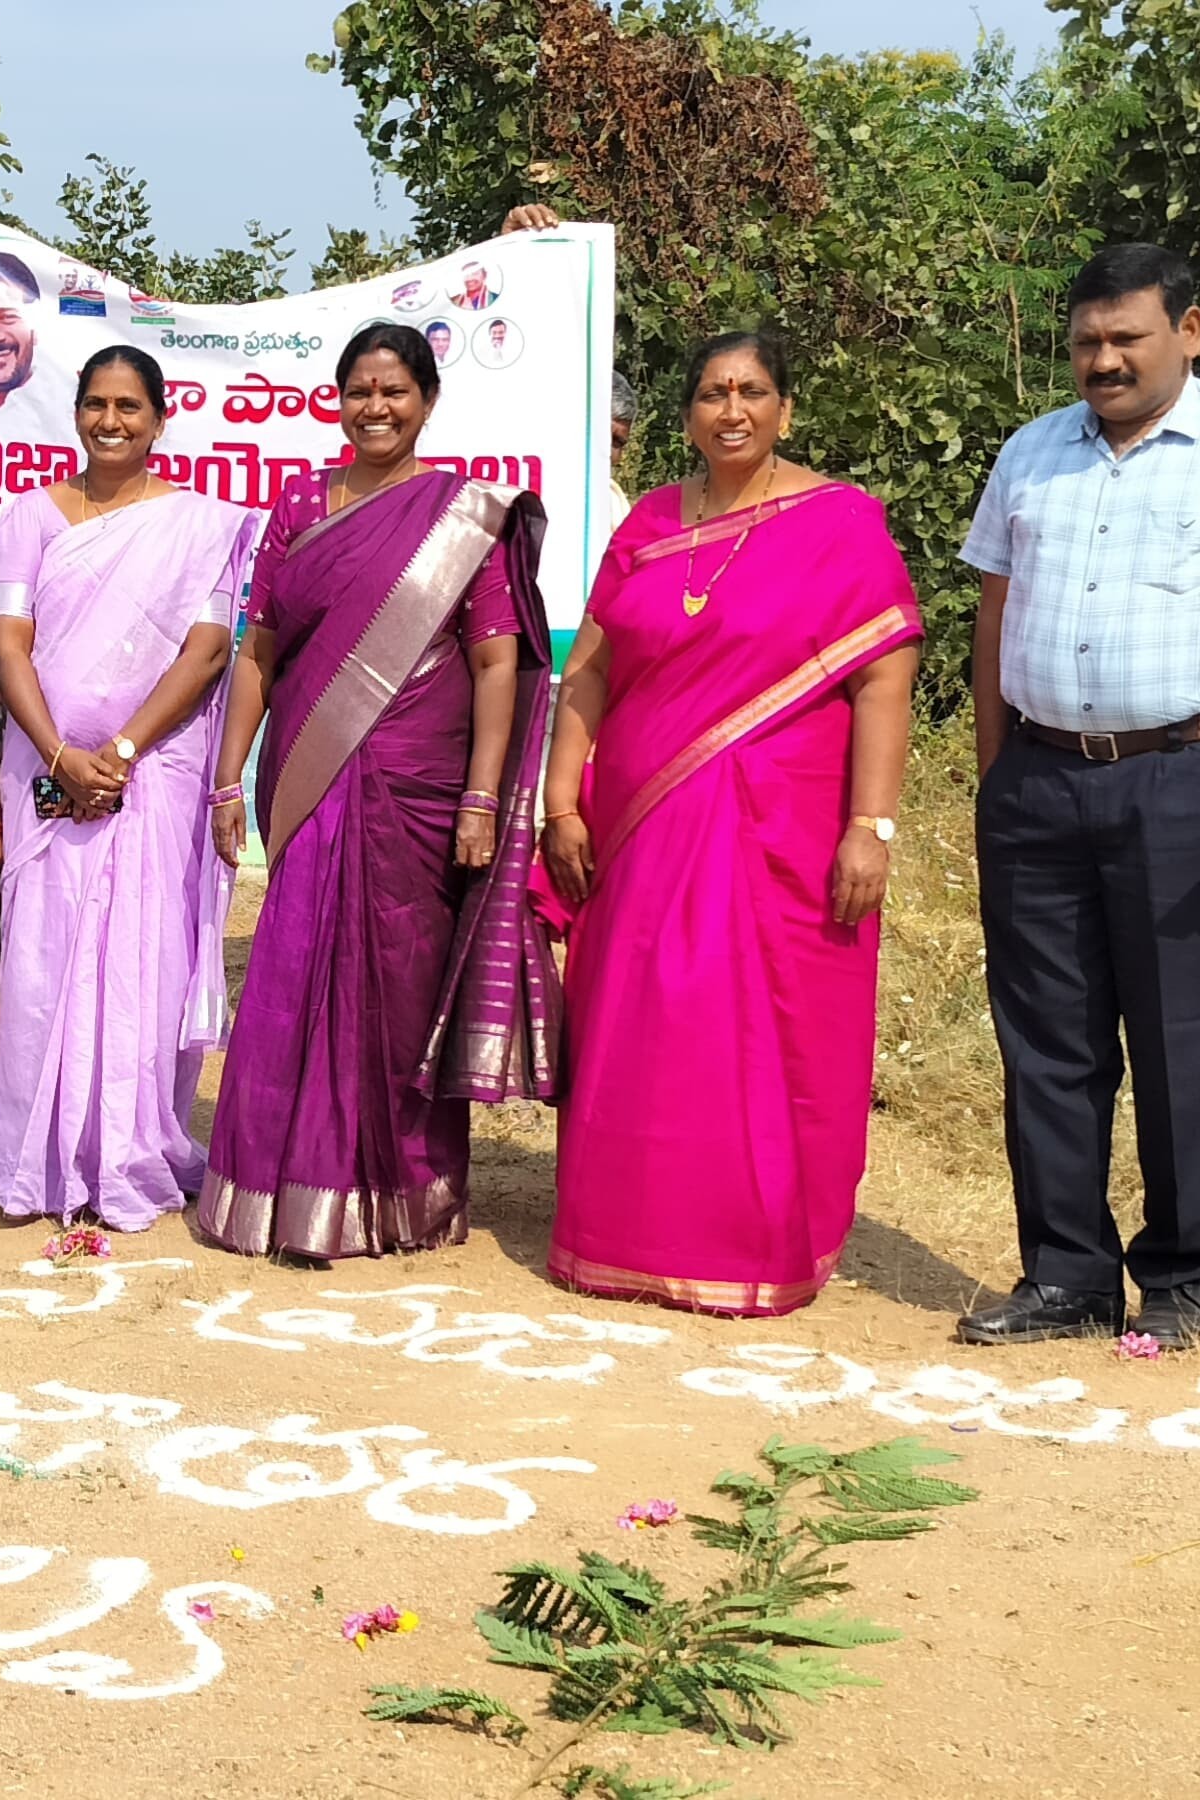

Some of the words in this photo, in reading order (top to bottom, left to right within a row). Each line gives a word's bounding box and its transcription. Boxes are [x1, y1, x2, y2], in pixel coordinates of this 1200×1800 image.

[160, 328, 240, 350] తెలంగాణ
[243, 329, 323, 359] ప్రభుత్వం
[222, 372, 343, 424] పాల
